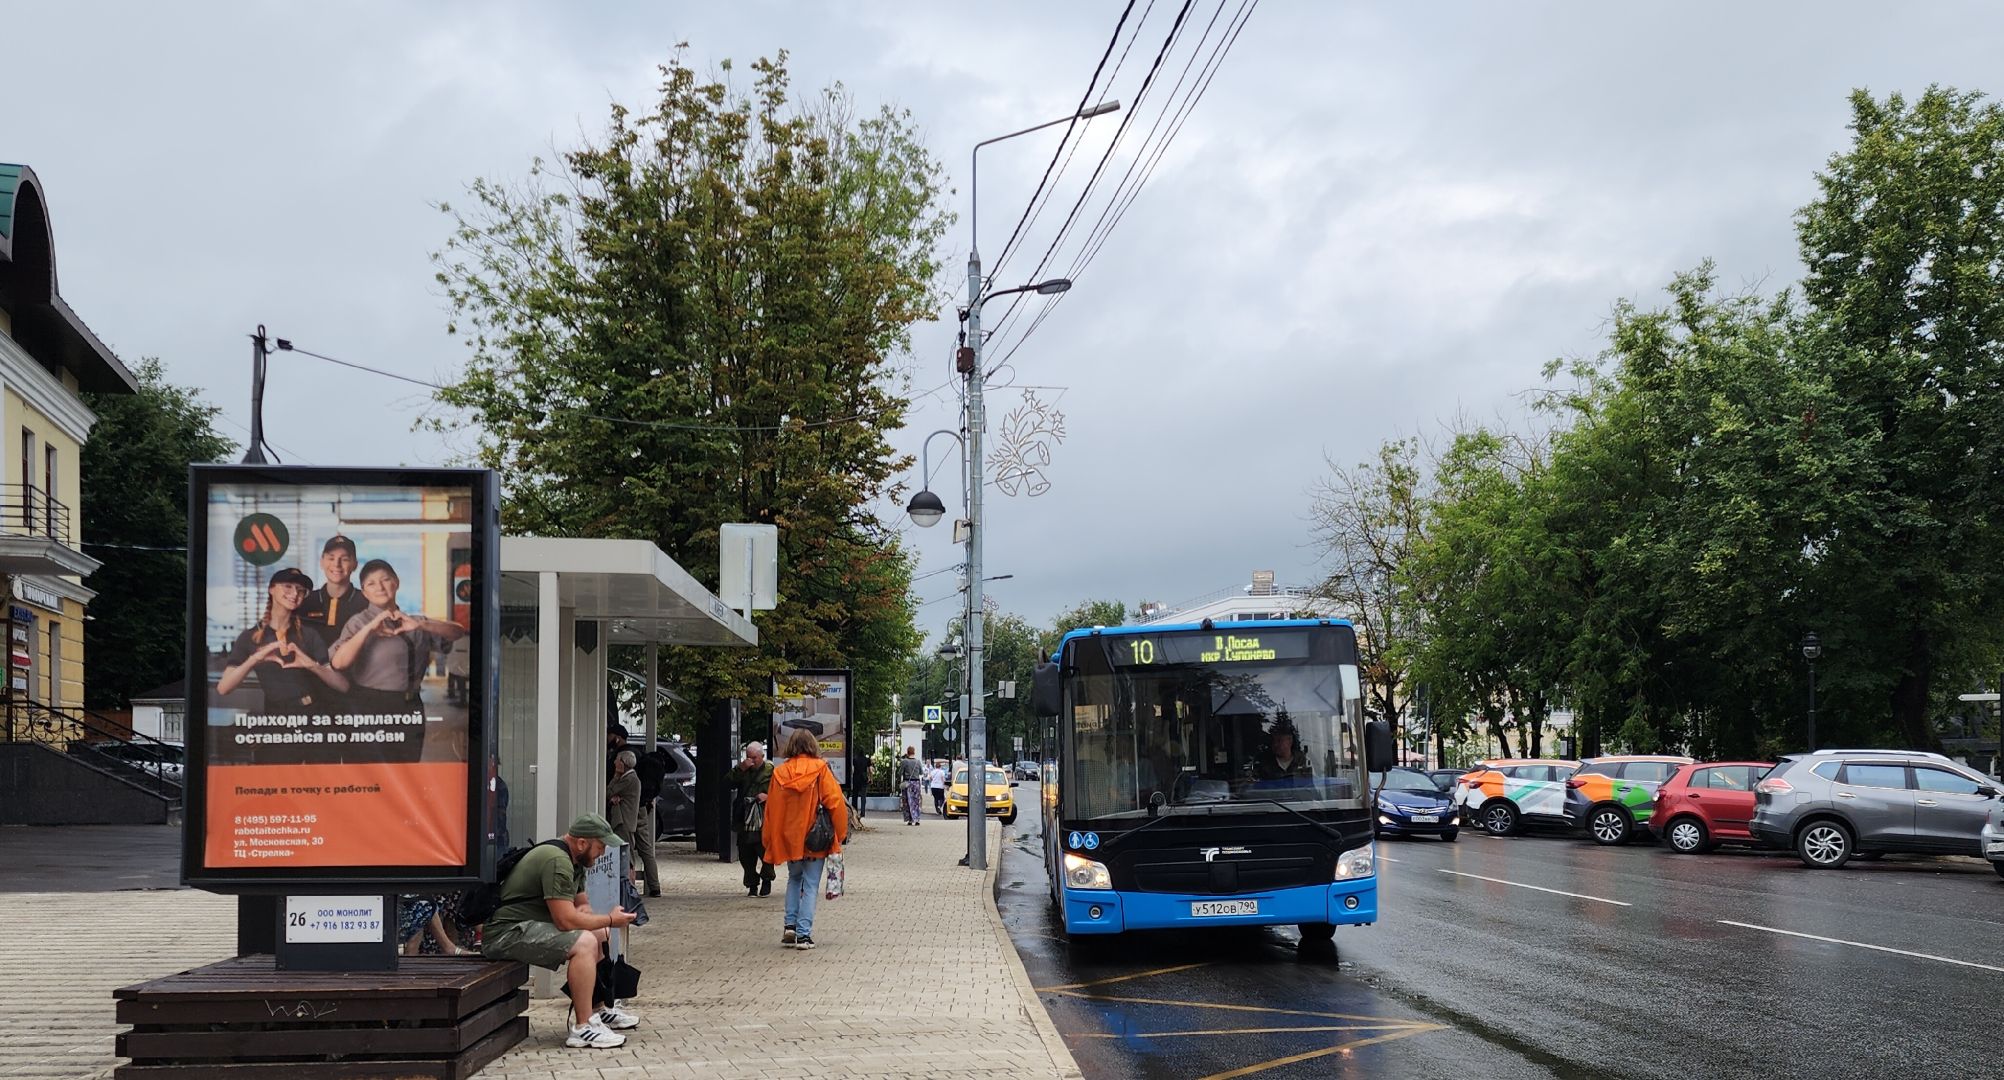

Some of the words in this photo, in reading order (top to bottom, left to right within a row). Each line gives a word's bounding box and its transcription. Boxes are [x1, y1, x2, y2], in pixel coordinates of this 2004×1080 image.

[1131, 640, 1154, 665] 10
[235, 712, 308, 729] Приходи
[312, 714, 331, 726] за
[335, 711, 423, 728] зарплатой
[235, 730, 323, 744] оставайся
[327, 732, 347, 743] по
[350, 730, 405, 743] любви
[235, 786, 278, 796] Попади
[291, 786, 321, 795] точку
[333, 784, 381, 795] работой
[234, 816, 241, 824] 8
[243, 815, 268, 825] (495)
[269, 814, 317, 824] 597-11-95
[234, 838, 248, 848] ул.
[249, 837, 310, 847] Московская,
[312, 836, 324, 845] 30
[234, 850, 247, 859] ТЦ
[317, 909, 334, 917] ООО
[336, 909, 373, 917] МОНОЛИТ
[310, 922, 321, 930] +7
[323, 922, 338, 930] 916
[340, 922, 355, 930] 182
[357, 921, 367, 929] 93
[370, 921, 380, 929] 87
